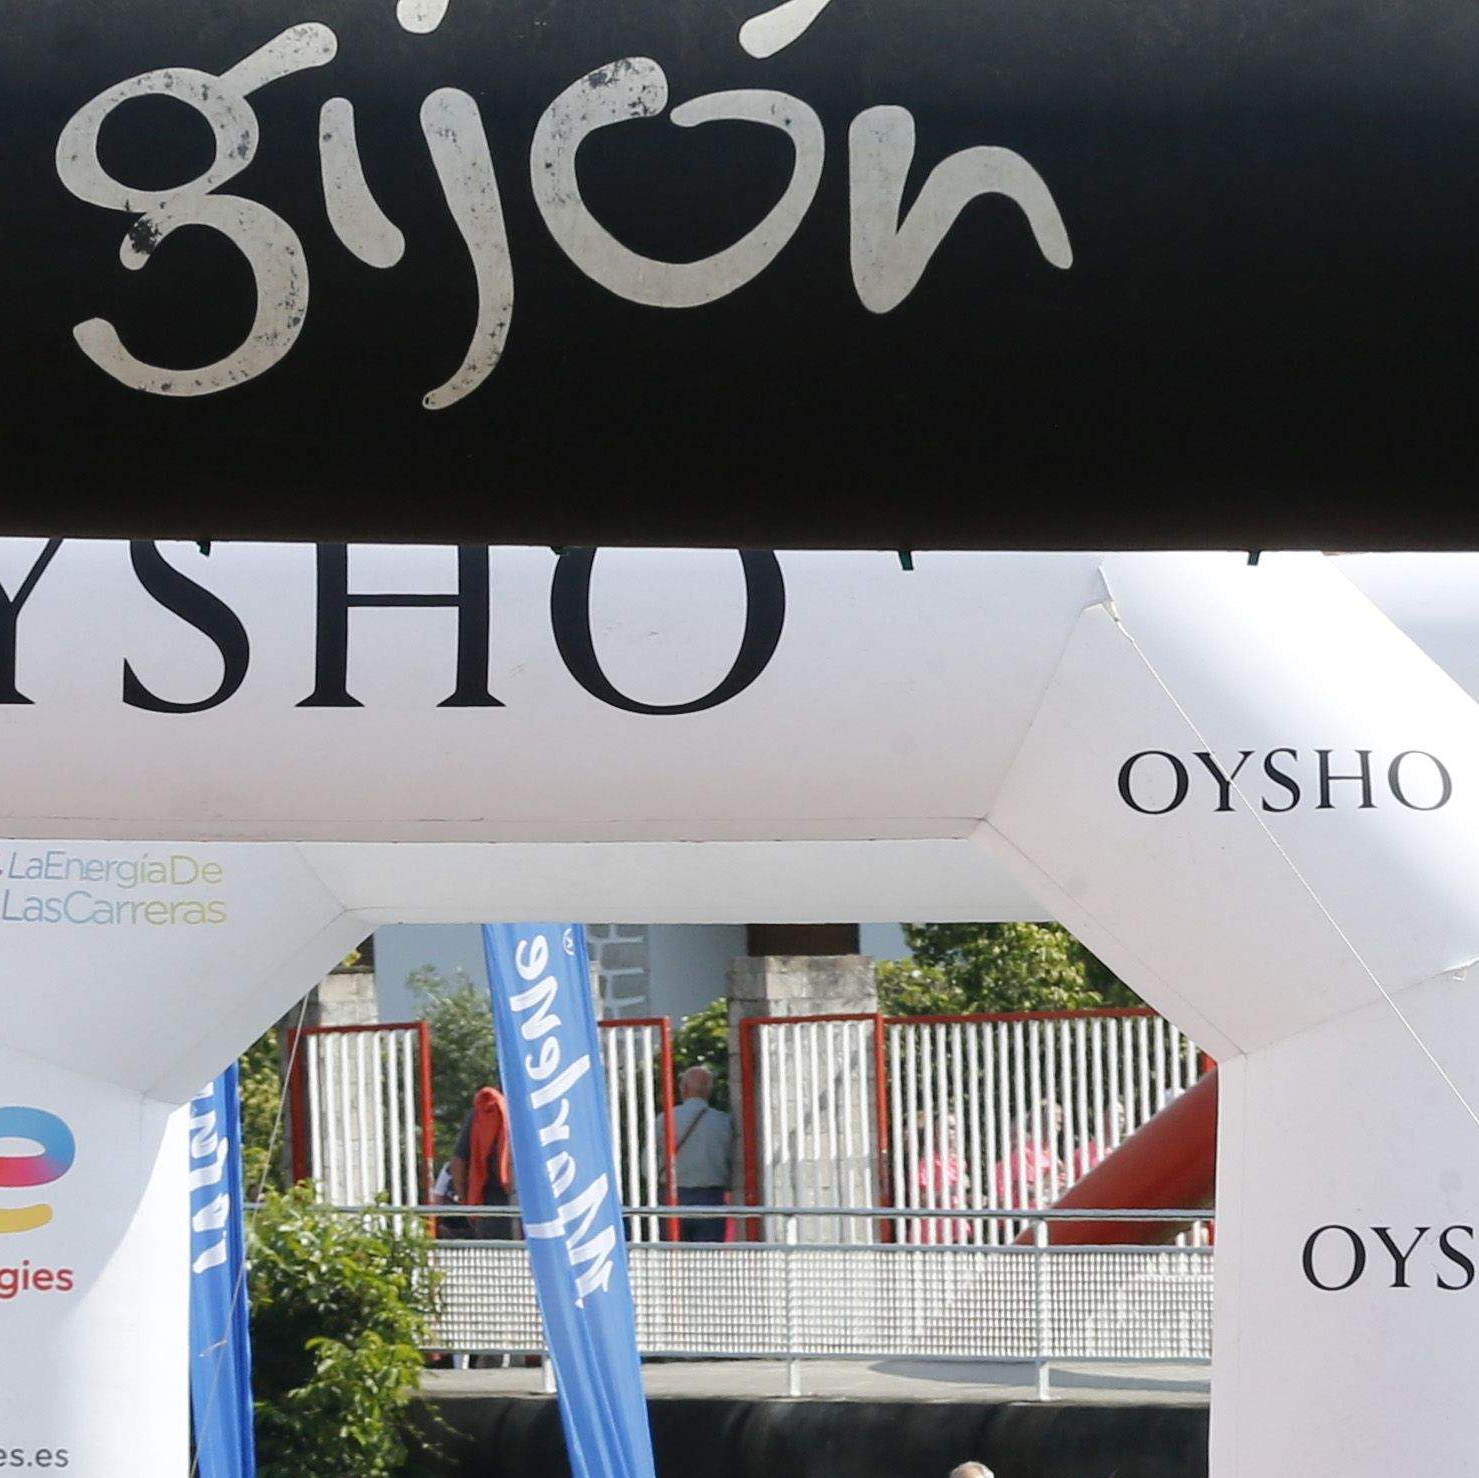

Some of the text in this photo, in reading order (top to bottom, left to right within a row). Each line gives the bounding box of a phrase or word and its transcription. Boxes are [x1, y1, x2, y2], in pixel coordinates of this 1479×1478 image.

[56, 0, 1073, 409] gijón
[1117, 748, 1453, 815] OYSHO
[2, 889, 227, 926] LasCarreras
